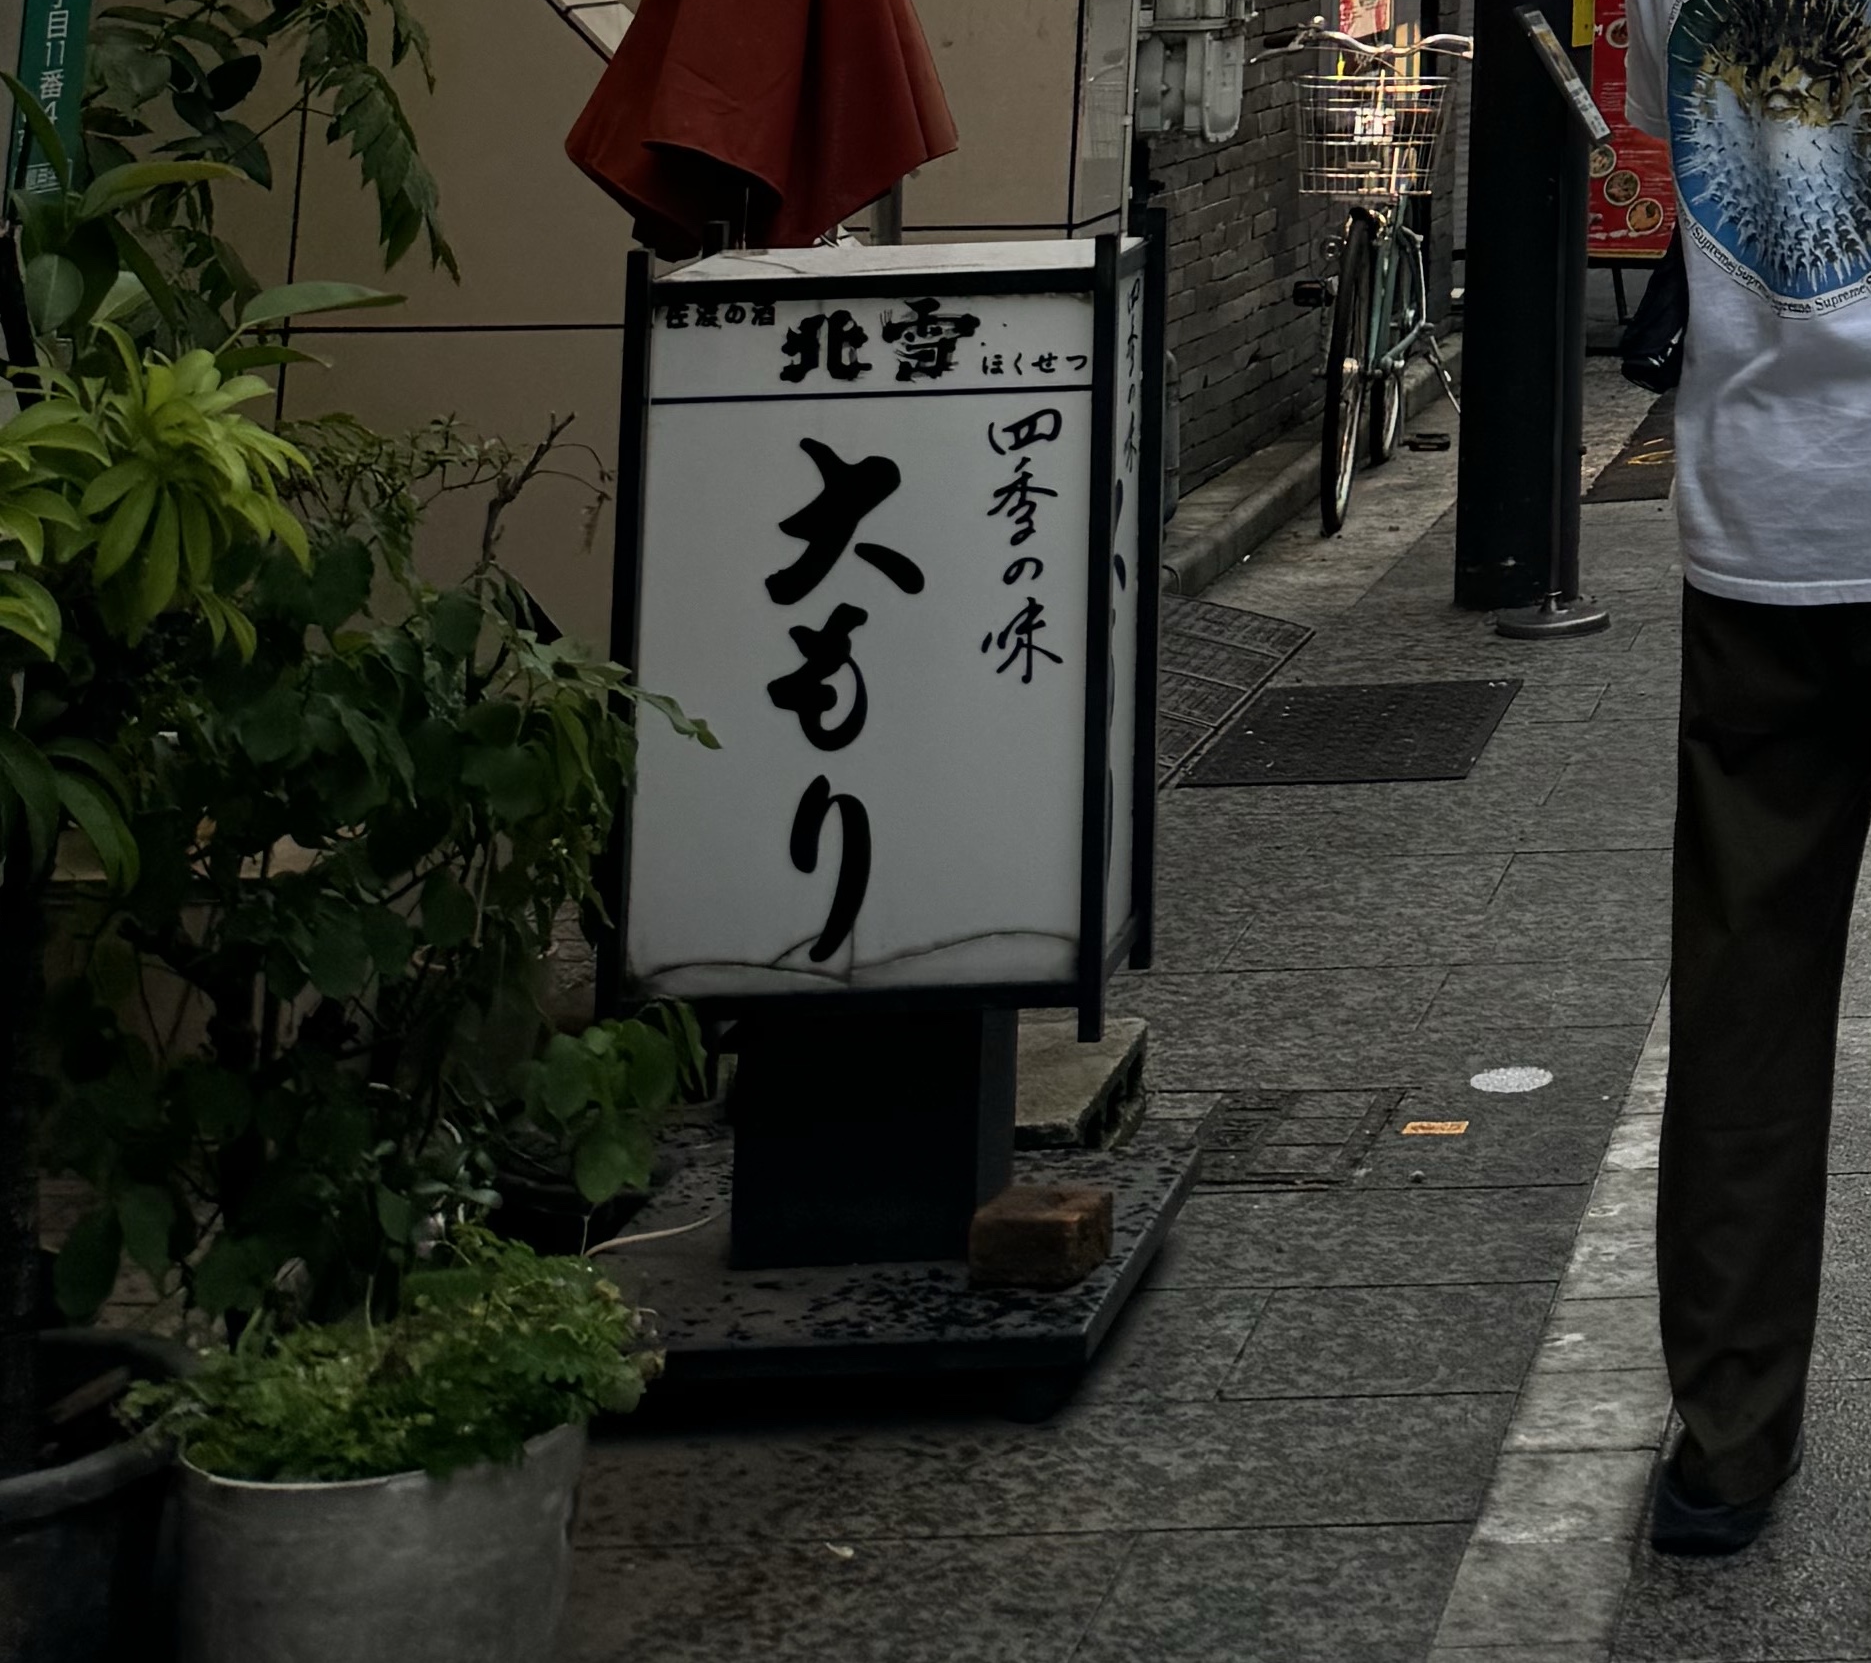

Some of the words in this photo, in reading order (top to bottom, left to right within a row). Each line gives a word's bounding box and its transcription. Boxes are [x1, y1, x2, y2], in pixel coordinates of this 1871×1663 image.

[779, 297, 981, 383] 北雪
[981, 351, 1089, 376] ほくせつ
[981, 407, 1064, 684] 四季の味
[764, 436, 925, 963] 大もり
